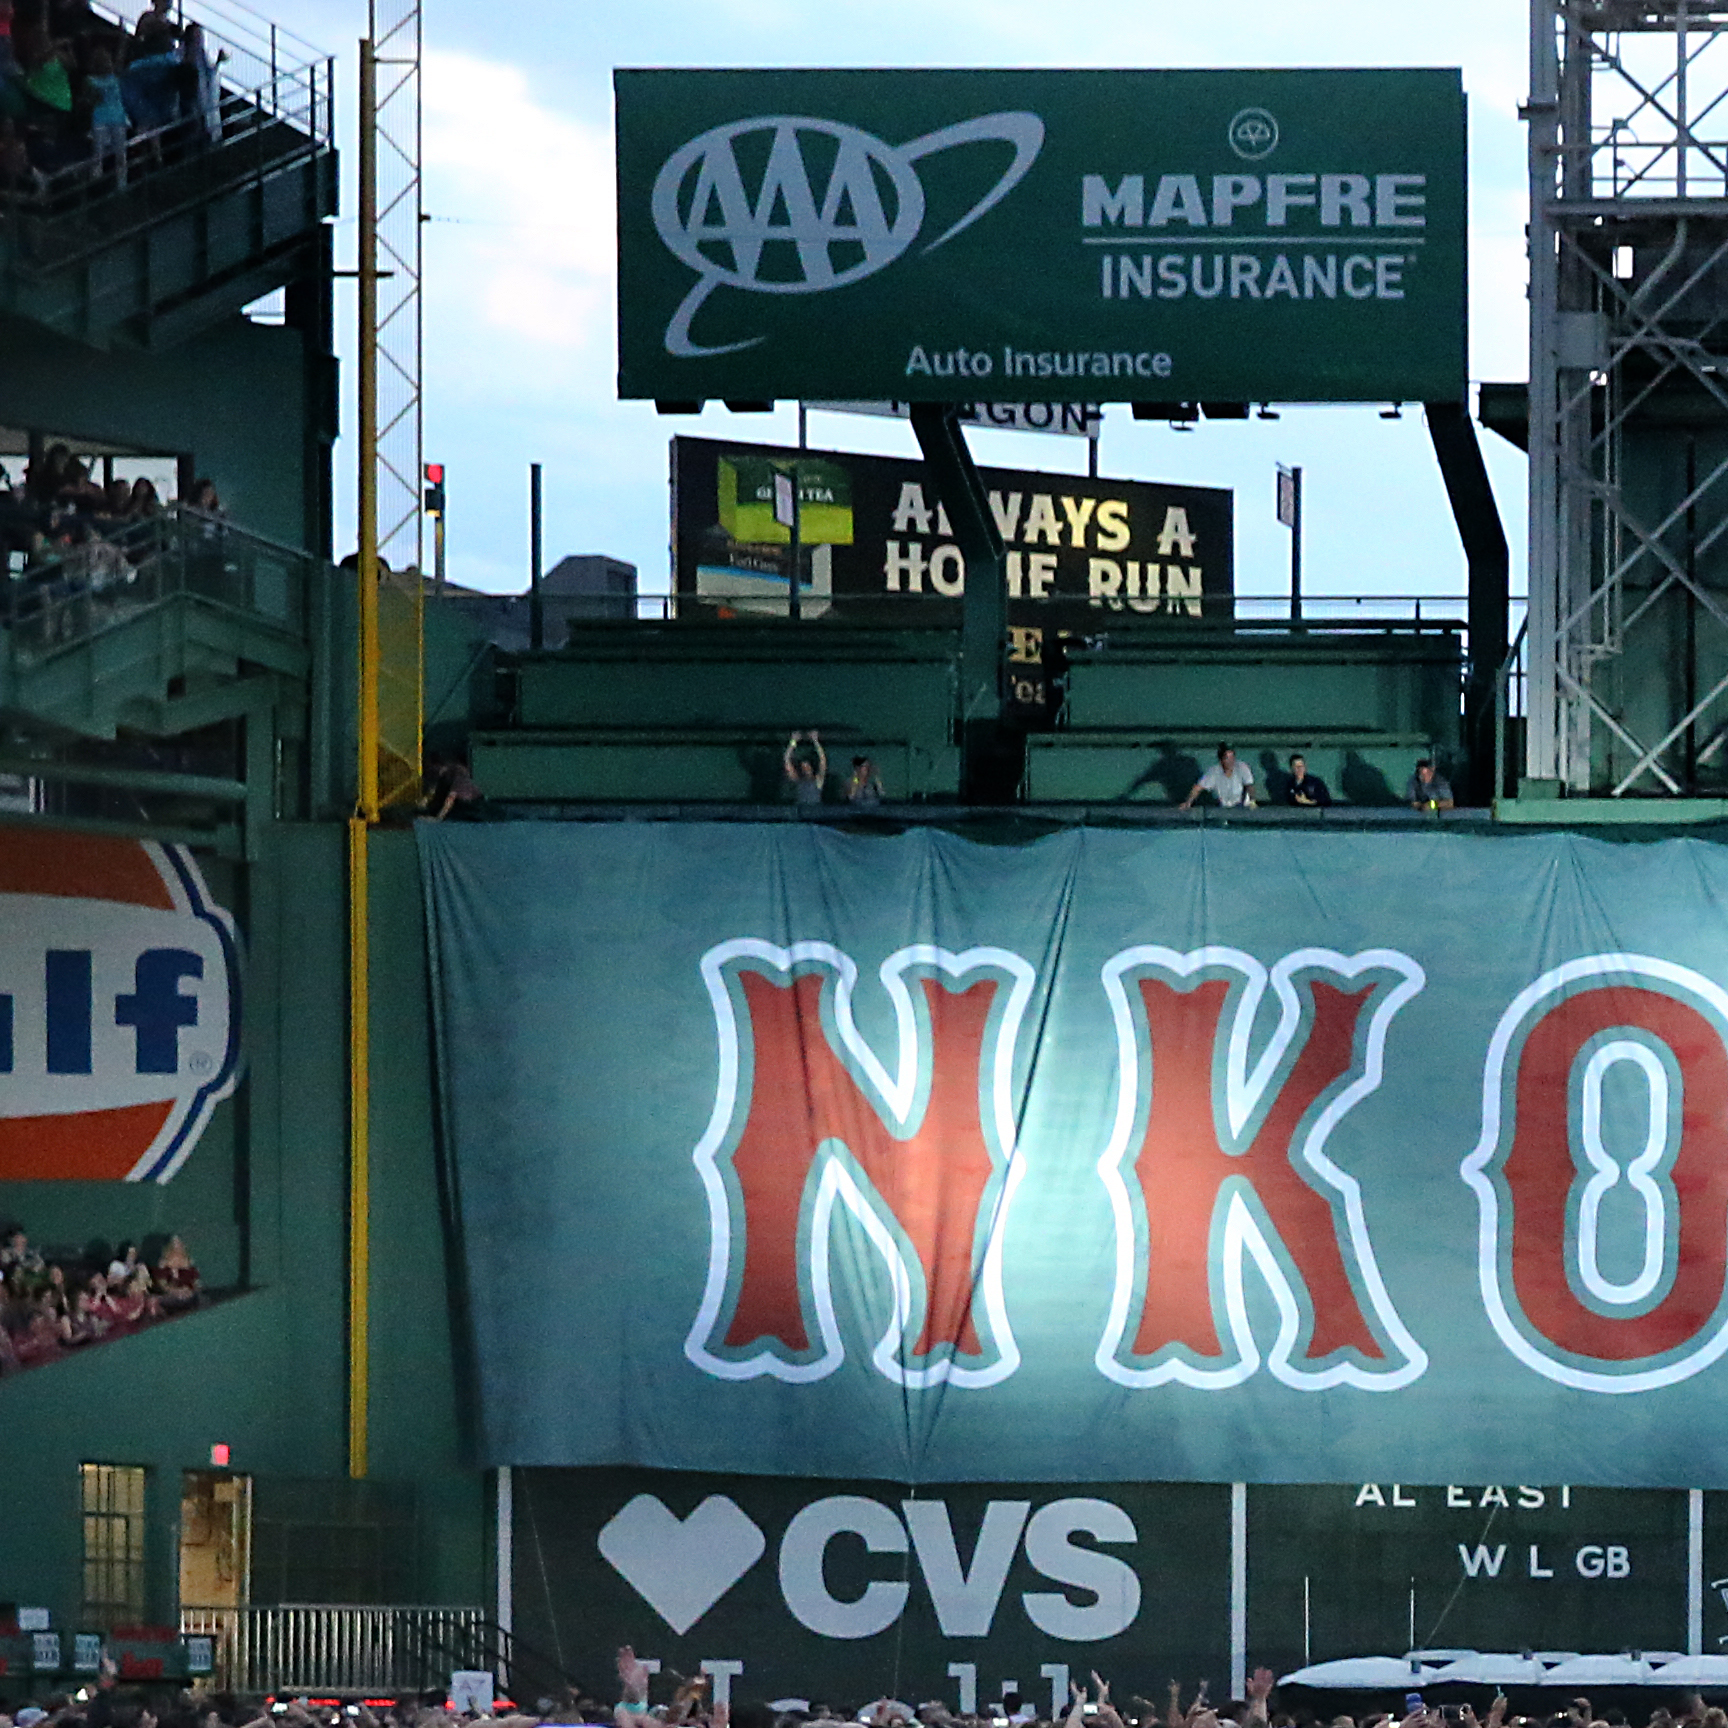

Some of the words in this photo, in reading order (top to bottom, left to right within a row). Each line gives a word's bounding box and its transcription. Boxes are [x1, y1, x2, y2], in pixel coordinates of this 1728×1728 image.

[672, 118, 902, 291] AAA
[1081, 173, 1426, 228] MAPFRE
[1101, 254, 1406, 300] INSURANCE
[905, 345, 993, 379] Auto
[1004, 346, 1173, 379] Insurance
[892, 481, 1131, 553] AWAYS
[1157, 505, 1197, 559] A
[1087, 557, 1203, 617] RUN
[1354, 1483, 1417, 1508] AL
[778, 1493, 1143, 1643] CVS
[1458, 1543, 1507, 1578] W
[1528, 1545, 1555, 1578] L
[1575, 1545, 1631, 1579] GB
